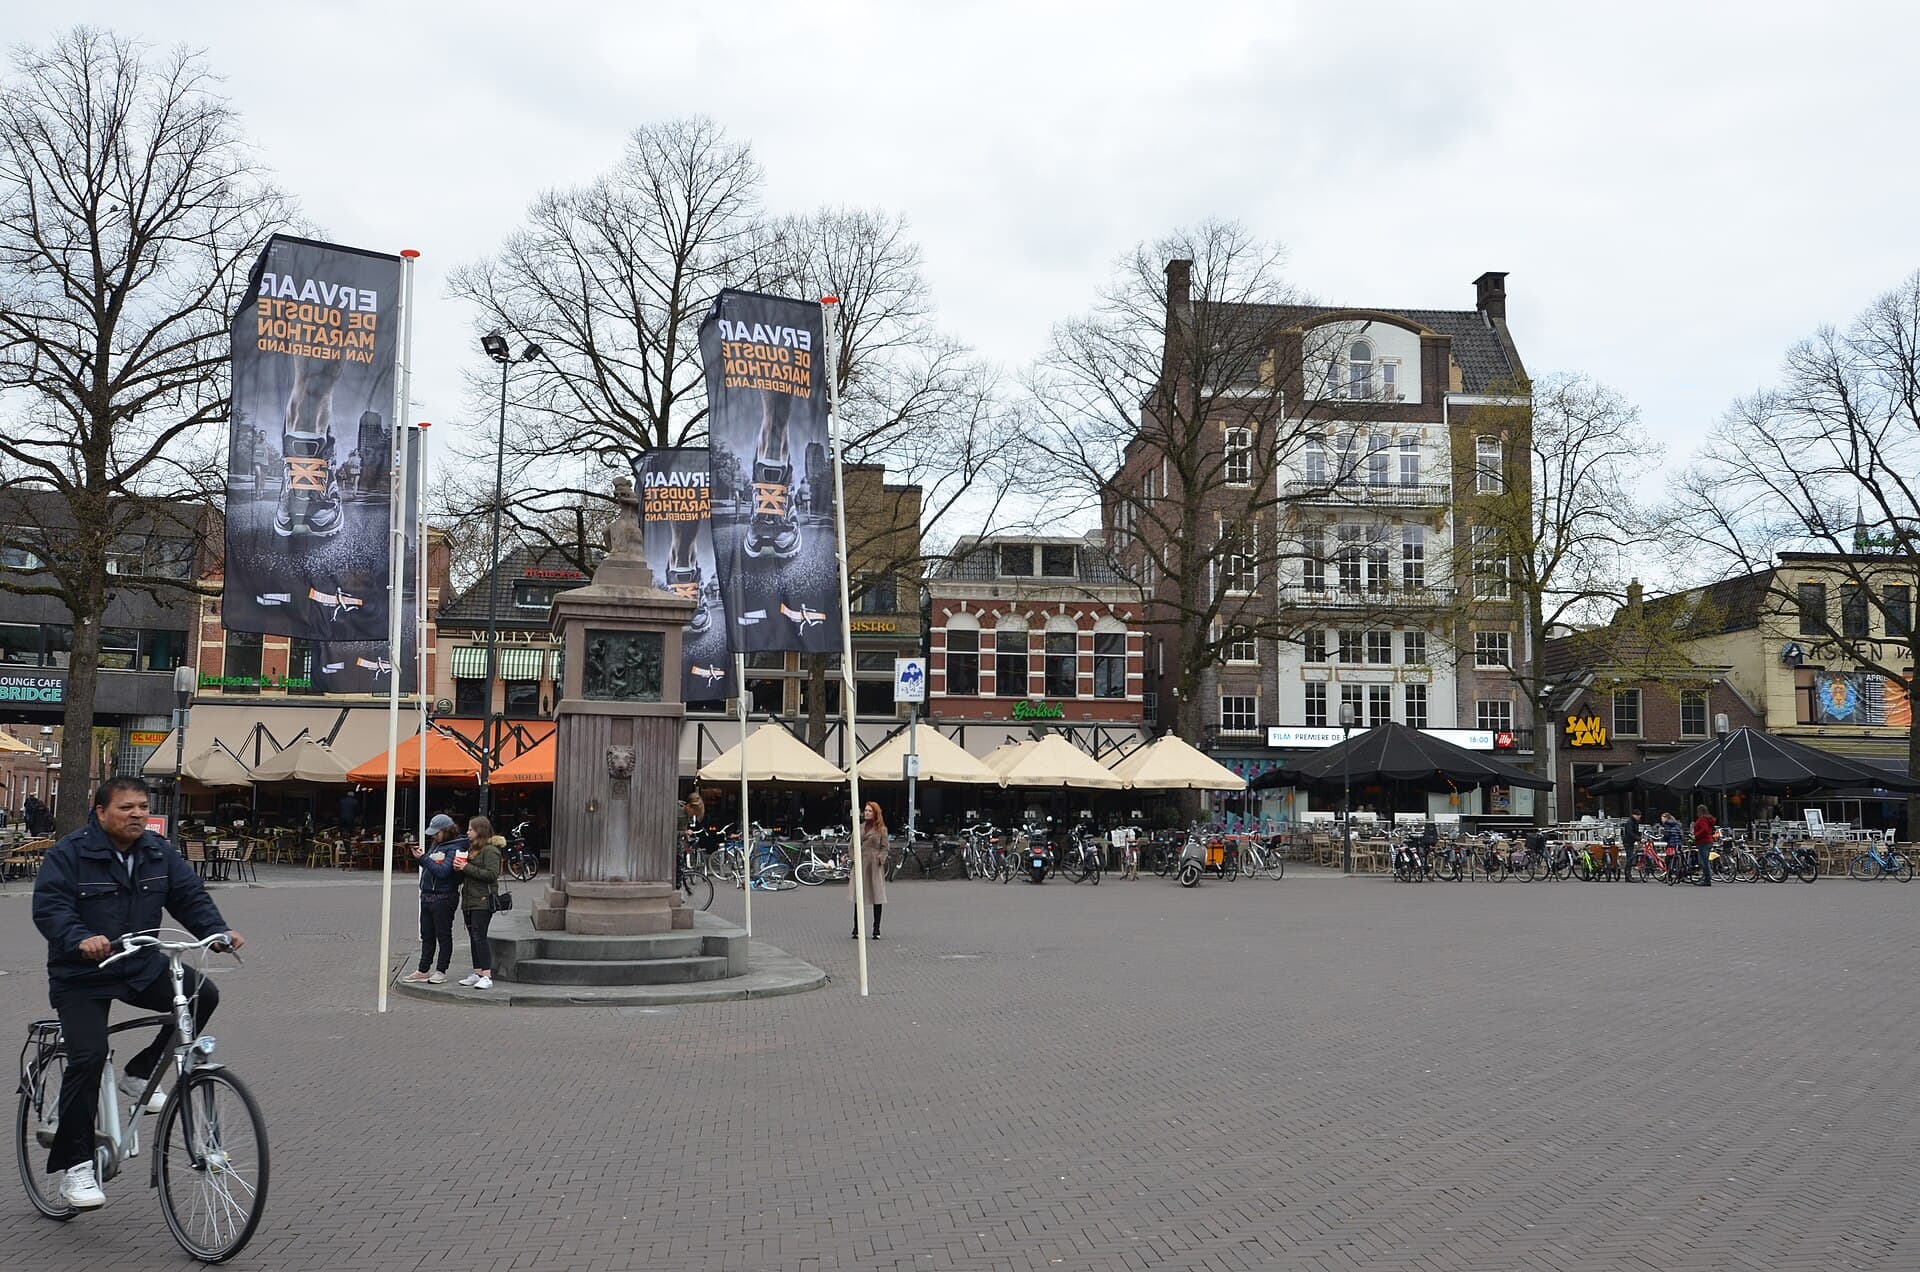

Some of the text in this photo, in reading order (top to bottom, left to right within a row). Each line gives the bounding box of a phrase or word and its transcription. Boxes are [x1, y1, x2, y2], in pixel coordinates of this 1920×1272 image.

[471, 630, 534, 644] MOLLY
[1809, 642, 1882, 661] ASEN
[0, 676, 62, 688] OUNGE CAFE
[259, 675, 271, 686] &
[0, 686, 63, 702] BRIDGE
[1012, 700, 1063, 721] Grolsch
[1565, 715, 1601, 733] SAM
[1273, 733, 1291, 741] FILM
[1498, 734, 1511, 746] illy
[1570, 728, 1606, 747] SAM
